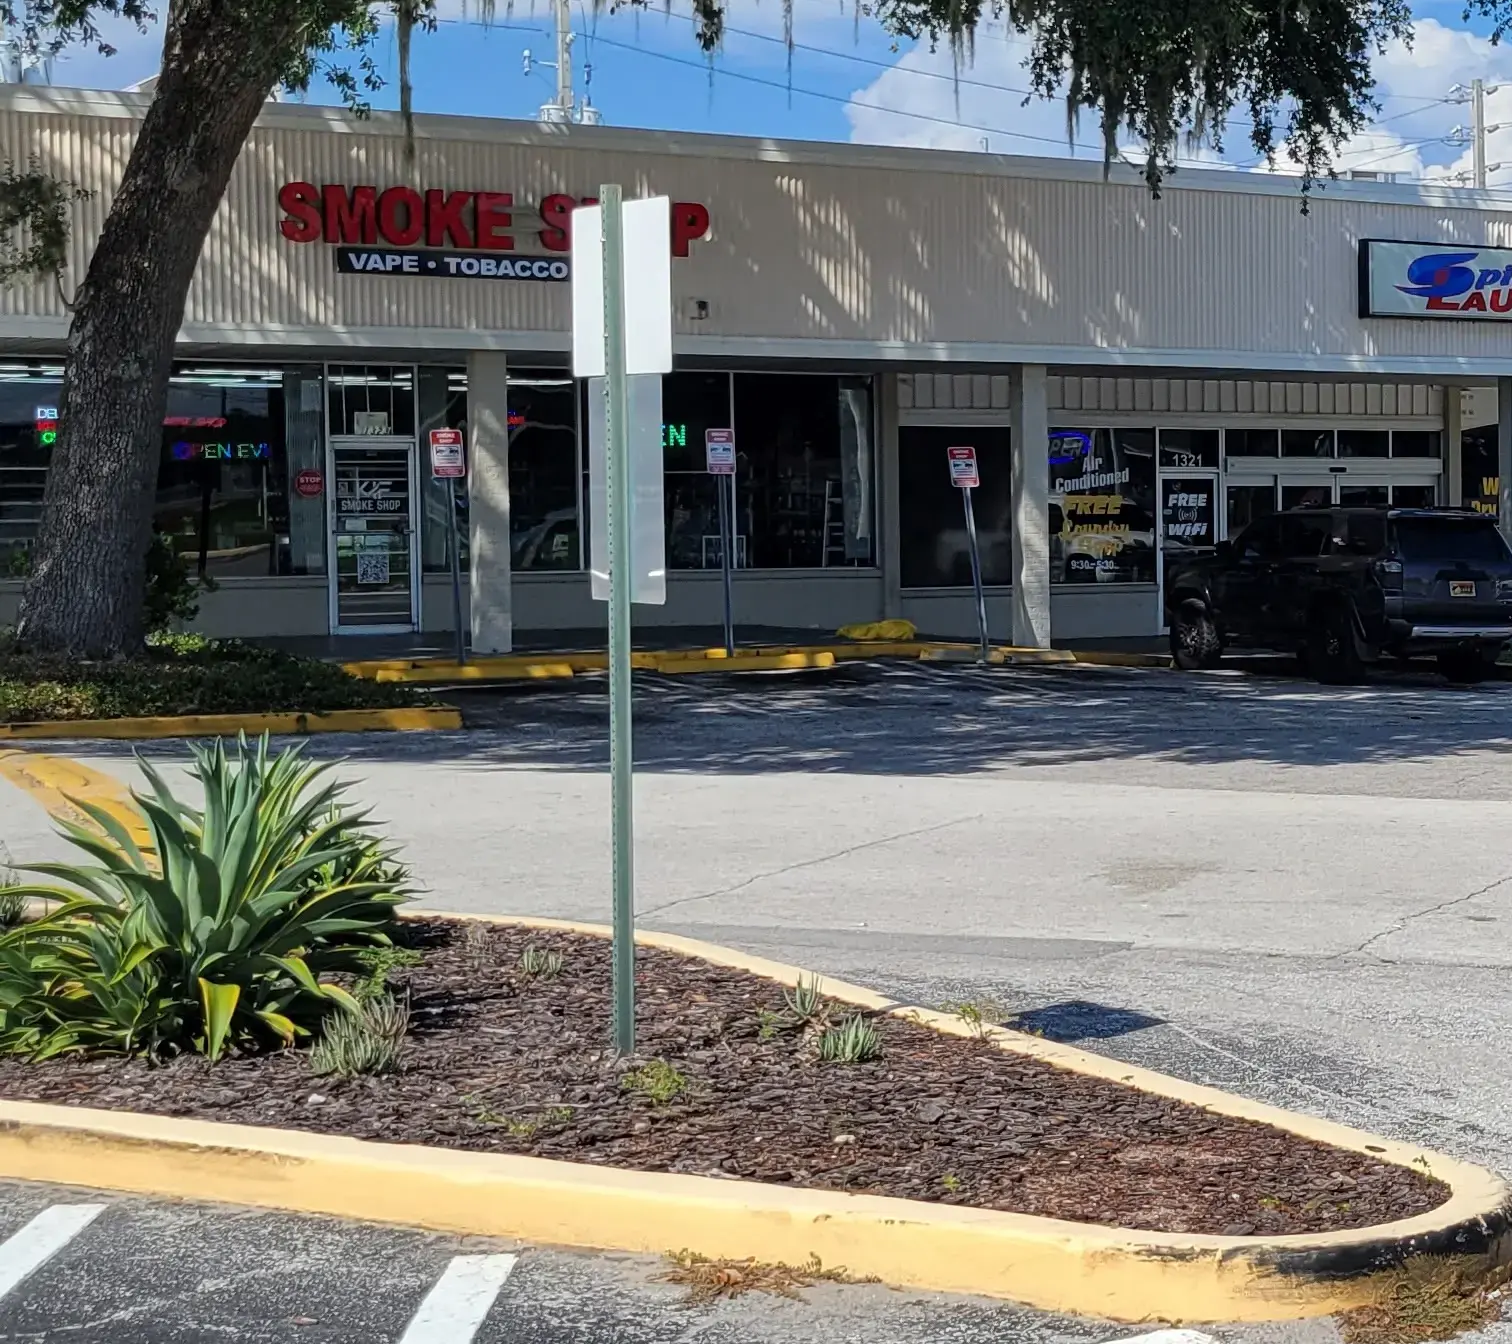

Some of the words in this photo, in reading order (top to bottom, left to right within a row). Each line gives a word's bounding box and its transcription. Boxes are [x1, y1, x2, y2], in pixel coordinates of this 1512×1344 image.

[279, 182, 514, 250] SMOKE
[539, 193, 709, 257] SP
[347, 252, 418, 272] VAPE
[444, 257, 569, 280] TOBACCO
[1082, 456, 1103, 473] Air
[1172, 453, 1203, 467] 1321
[300, 476, 321, 484] STOP
[1055, 467, 1130, 494] Conditioned
[341, 500, 374, 511] SMOKE
[376, 500, 401, 511] SHOP
[1062, 494, 1123, 515] FREE
[1168, 492, 1208, 507] FREE
